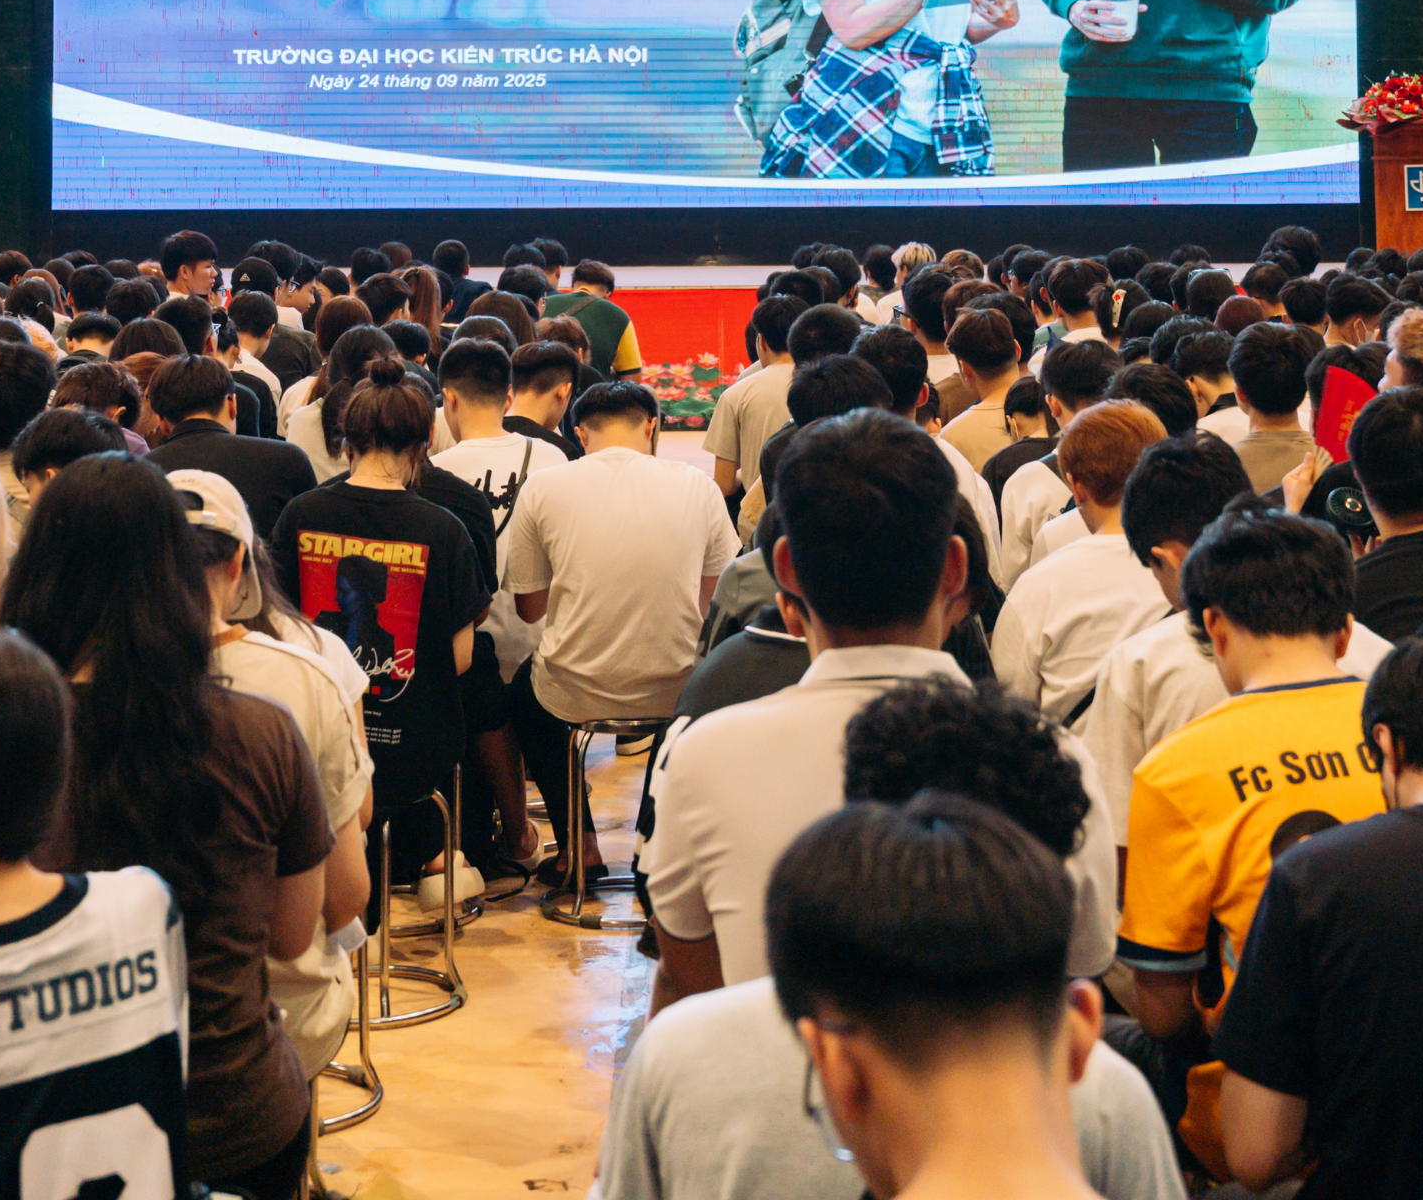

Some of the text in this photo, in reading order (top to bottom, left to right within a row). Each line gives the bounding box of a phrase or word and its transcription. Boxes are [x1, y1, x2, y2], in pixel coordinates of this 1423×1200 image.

[233, 45, 333, 64] TRƯỜNG
[339, 48, 378, 68] ĐẠI
[385, 48, 434, 68] HỌC
[500, 44, 568, 64] TRÚC
[570, 44, 602, 63] HÀ
[608, 45, 647, 67] NỘI
[309, 73, 546, 90] Ngày 24 tháng 09 năm 2025
[298, 532, 425, 568] STARGIRL
[1228, 765, 1273, 803] Fc
[1279, 750, 1350, 785] Sơn
